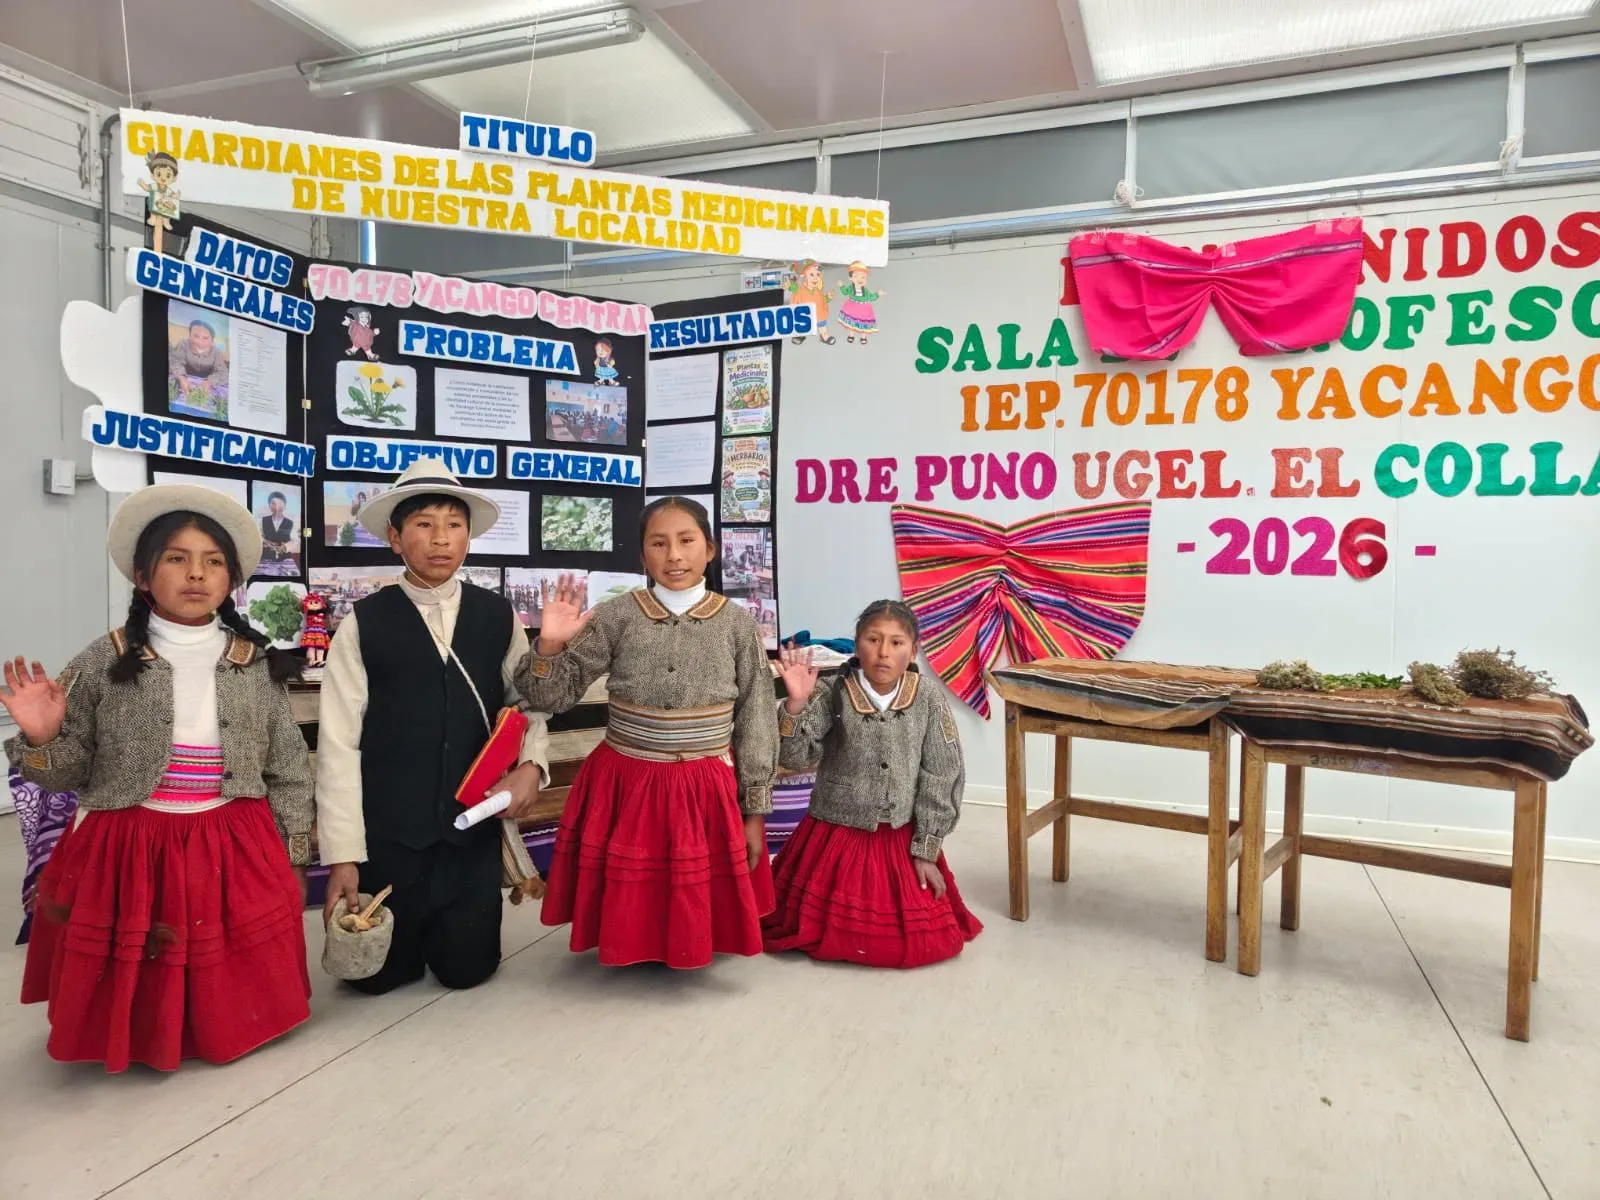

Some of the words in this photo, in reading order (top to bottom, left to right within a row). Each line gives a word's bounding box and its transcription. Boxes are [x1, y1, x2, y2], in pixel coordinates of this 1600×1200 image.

[463, 116, 593, 163] TITULO
[127, 121, 382, 183] GUARDIANES
[394, 155, 440, 188] DE
[446, 159, 514, 196] LAS
[528, 171, 672, 216] PLANTAS
[681, 191, 884, 238] MEDICINALES
[292, 178, 345, 212] DE
[360, 186, 532, 232] NUESTRA
[555, 208, 741, 255] LOCALIDAD
[195, 231, 293, 286] DATOS
[136, 251, 315, 333] GENERALES
[415, 273, 535, 316] YACANGO
[403, 323, 575, 371] PROBLEMA
[649, 305, 812, 349] RESULTADOS
[915, 318, 1079, 373] SALA
[92, 410, 316, 476] JUSTIFICACION
[511, 452, 641, 486] GENERAL
[795, 457, 899, 503] DRE
[915, 452, 1057, 501] PUNO
[1270, 448, 1361, 498] EL
[1205, 517, 1388, 579] 2026
